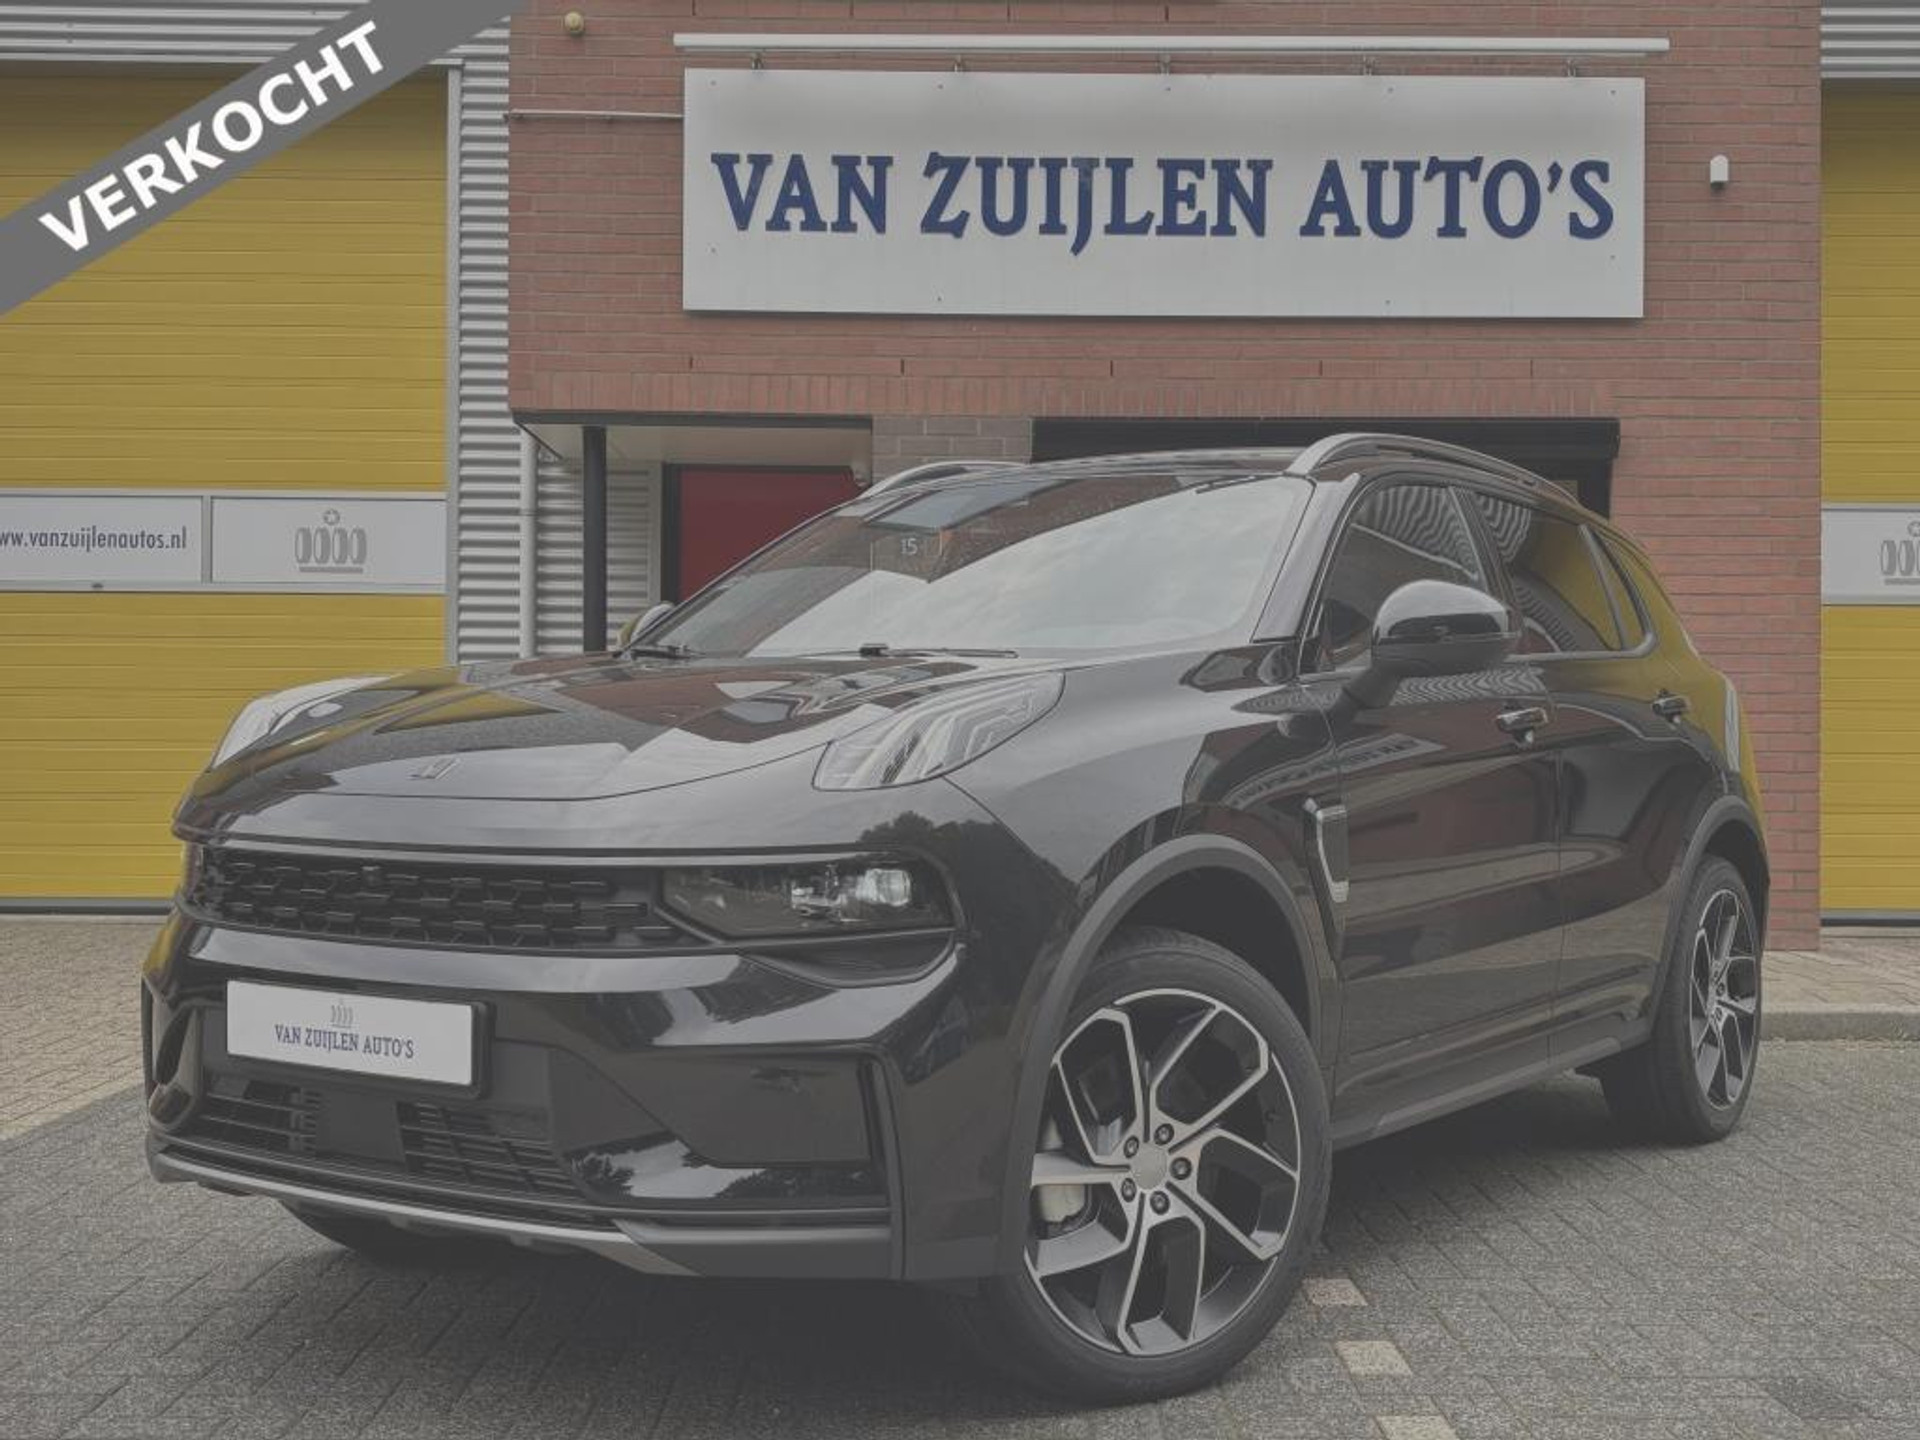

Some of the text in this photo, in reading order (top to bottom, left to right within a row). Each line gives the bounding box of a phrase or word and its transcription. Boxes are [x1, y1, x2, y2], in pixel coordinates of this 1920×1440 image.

[710, 151, 1614, 257] VAN ZUIJLEN AUTO'S
[275, 1025, 414, 1059] VAN ZUIJLEN AUTO'S
